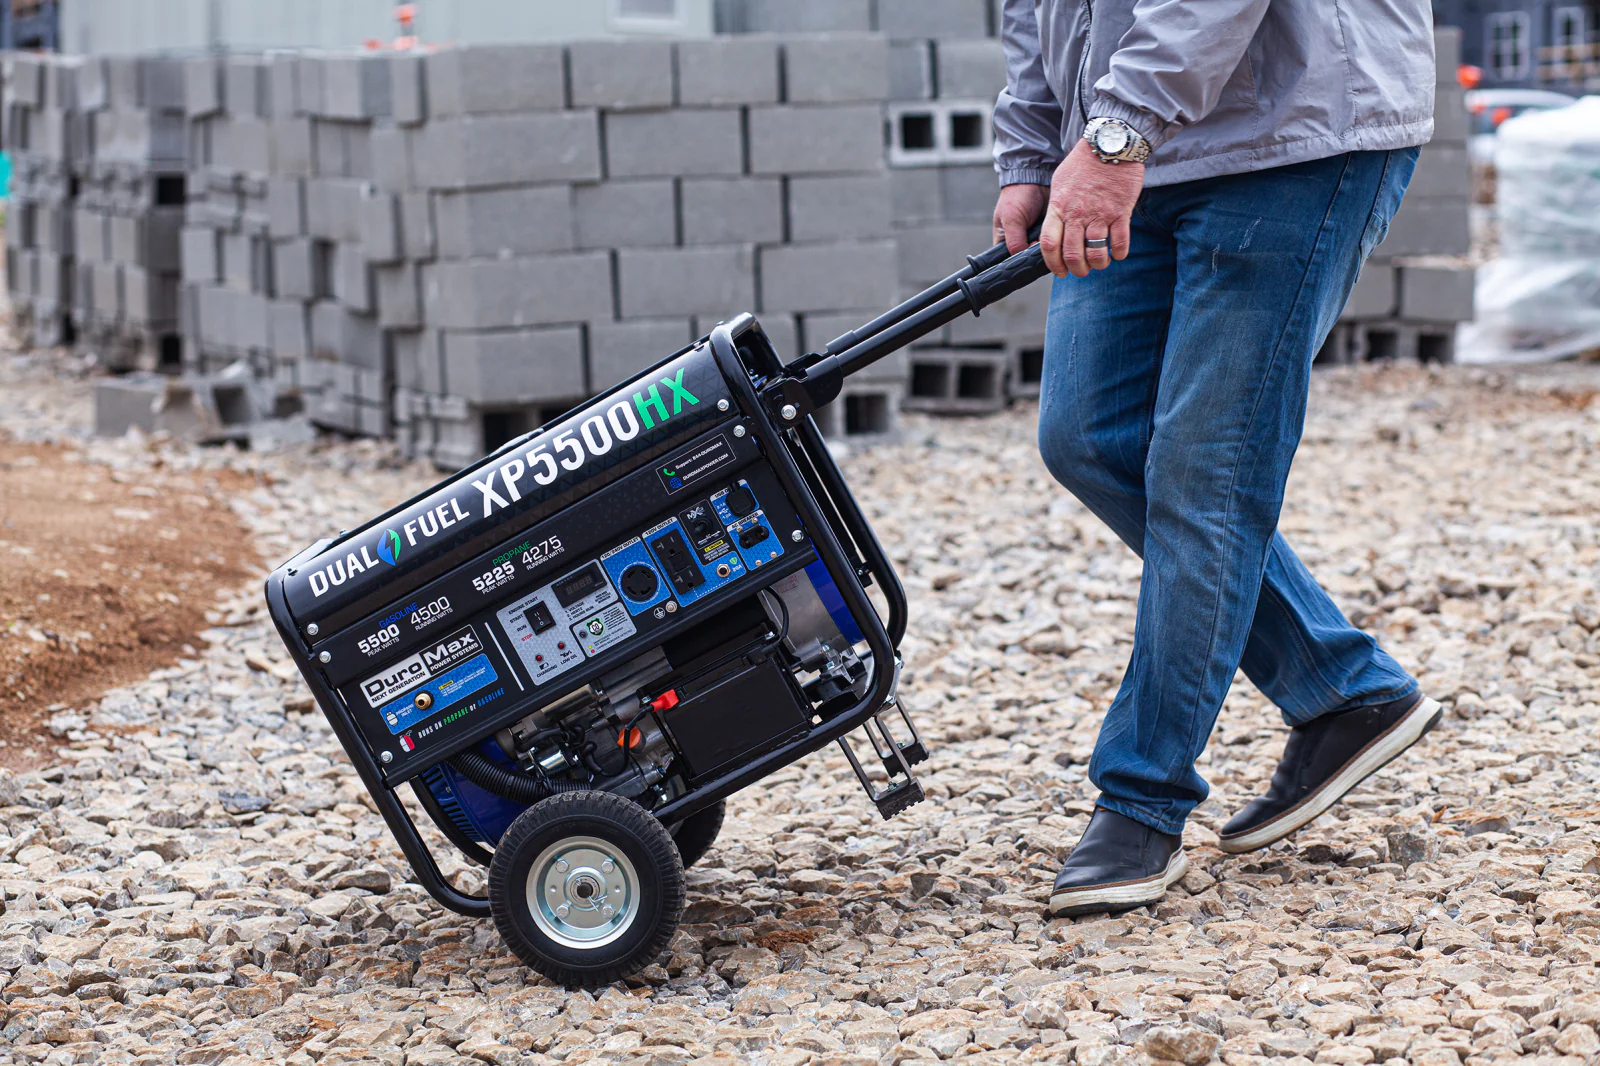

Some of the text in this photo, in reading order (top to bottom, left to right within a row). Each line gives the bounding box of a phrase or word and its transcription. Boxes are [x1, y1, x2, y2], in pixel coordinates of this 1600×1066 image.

[308, 367, 700, 598] DUAL FUEL XP5500HX
[491, 541, 532, 567] PROPANE
[523, 535, 563, 564] 4275
[526, 547, 565, 571] RUNNING WATTS
[472, 560, 516, 592] 5225
[482, 574, 515, 595] PEAK WATTS
[411, 595, 451, 625] 4500
[524, 596, 539, 606] START
[378, 602, 419, 630] GASOLINE
[415, 607, 453, 631] RUNNING WATTS
[509, 614, 524, 624] START
[516, 624, 527, 632] RUN
[358, 623, 401, 654] 5500
[367, 637, 400, 657] PEAK WATTS
[521, 633, 533, 642] STOP
[371, 691, 388, 703] NEXT
[388, 671, 426, 694] GENERATION
[430, 657, 451, 671] POWER
[451, 642, 479, 660] SYSTEMS
[536, 664, 558, 678] CHARGING
[560, 657, 571, 665] LOW
[418, 726, 434, 739] RUNS
[434, 721, 443, 730] ON
[443, 707, 469, 725] PROPANE
[477, 688, 505, 707] GASOLINE
